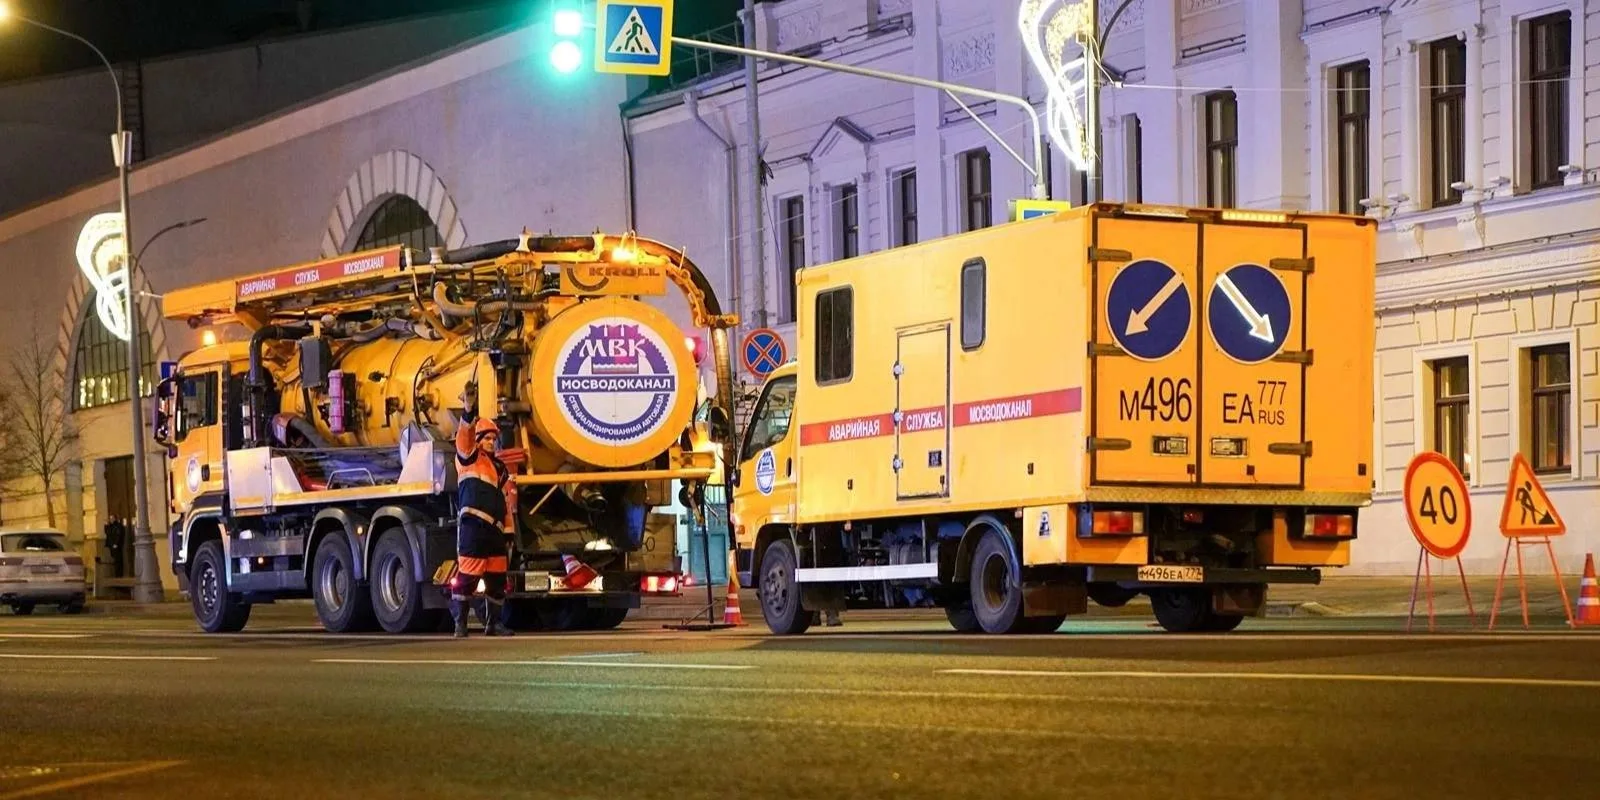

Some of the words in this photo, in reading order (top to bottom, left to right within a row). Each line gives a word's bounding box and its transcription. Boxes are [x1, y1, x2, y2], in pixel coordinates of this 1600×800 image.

[240, 276, 276, 296] АВАРИЙНАЯ
[294, 269, 320, 285] СЛУЖБА
[343, 255, 385, 276] МОСВОДОКАНАЛ
[588, 266, 660, 277] KROLL
[579, 338, 646, 357] МВК
[561, 378, 671, 391] МОСВОДОКАНАЛ
[1257, 380, 1287, 406] 777
[568, 395, 642, 436] СПЕЦИАЛИЗИРОВАННАЯ
[642, 394, 664, 428] АВТОБАЗА
[828, 419, 880, 441] АВАРИЙНАЯ
[906, 411, 943, 431] СЛУЖБА
[969, 399, 1032, 423] МОСВОДОКАНАЛ
[1258, 409, 1285, 426] RUS
[1419, 485, 1457, 525] 40
